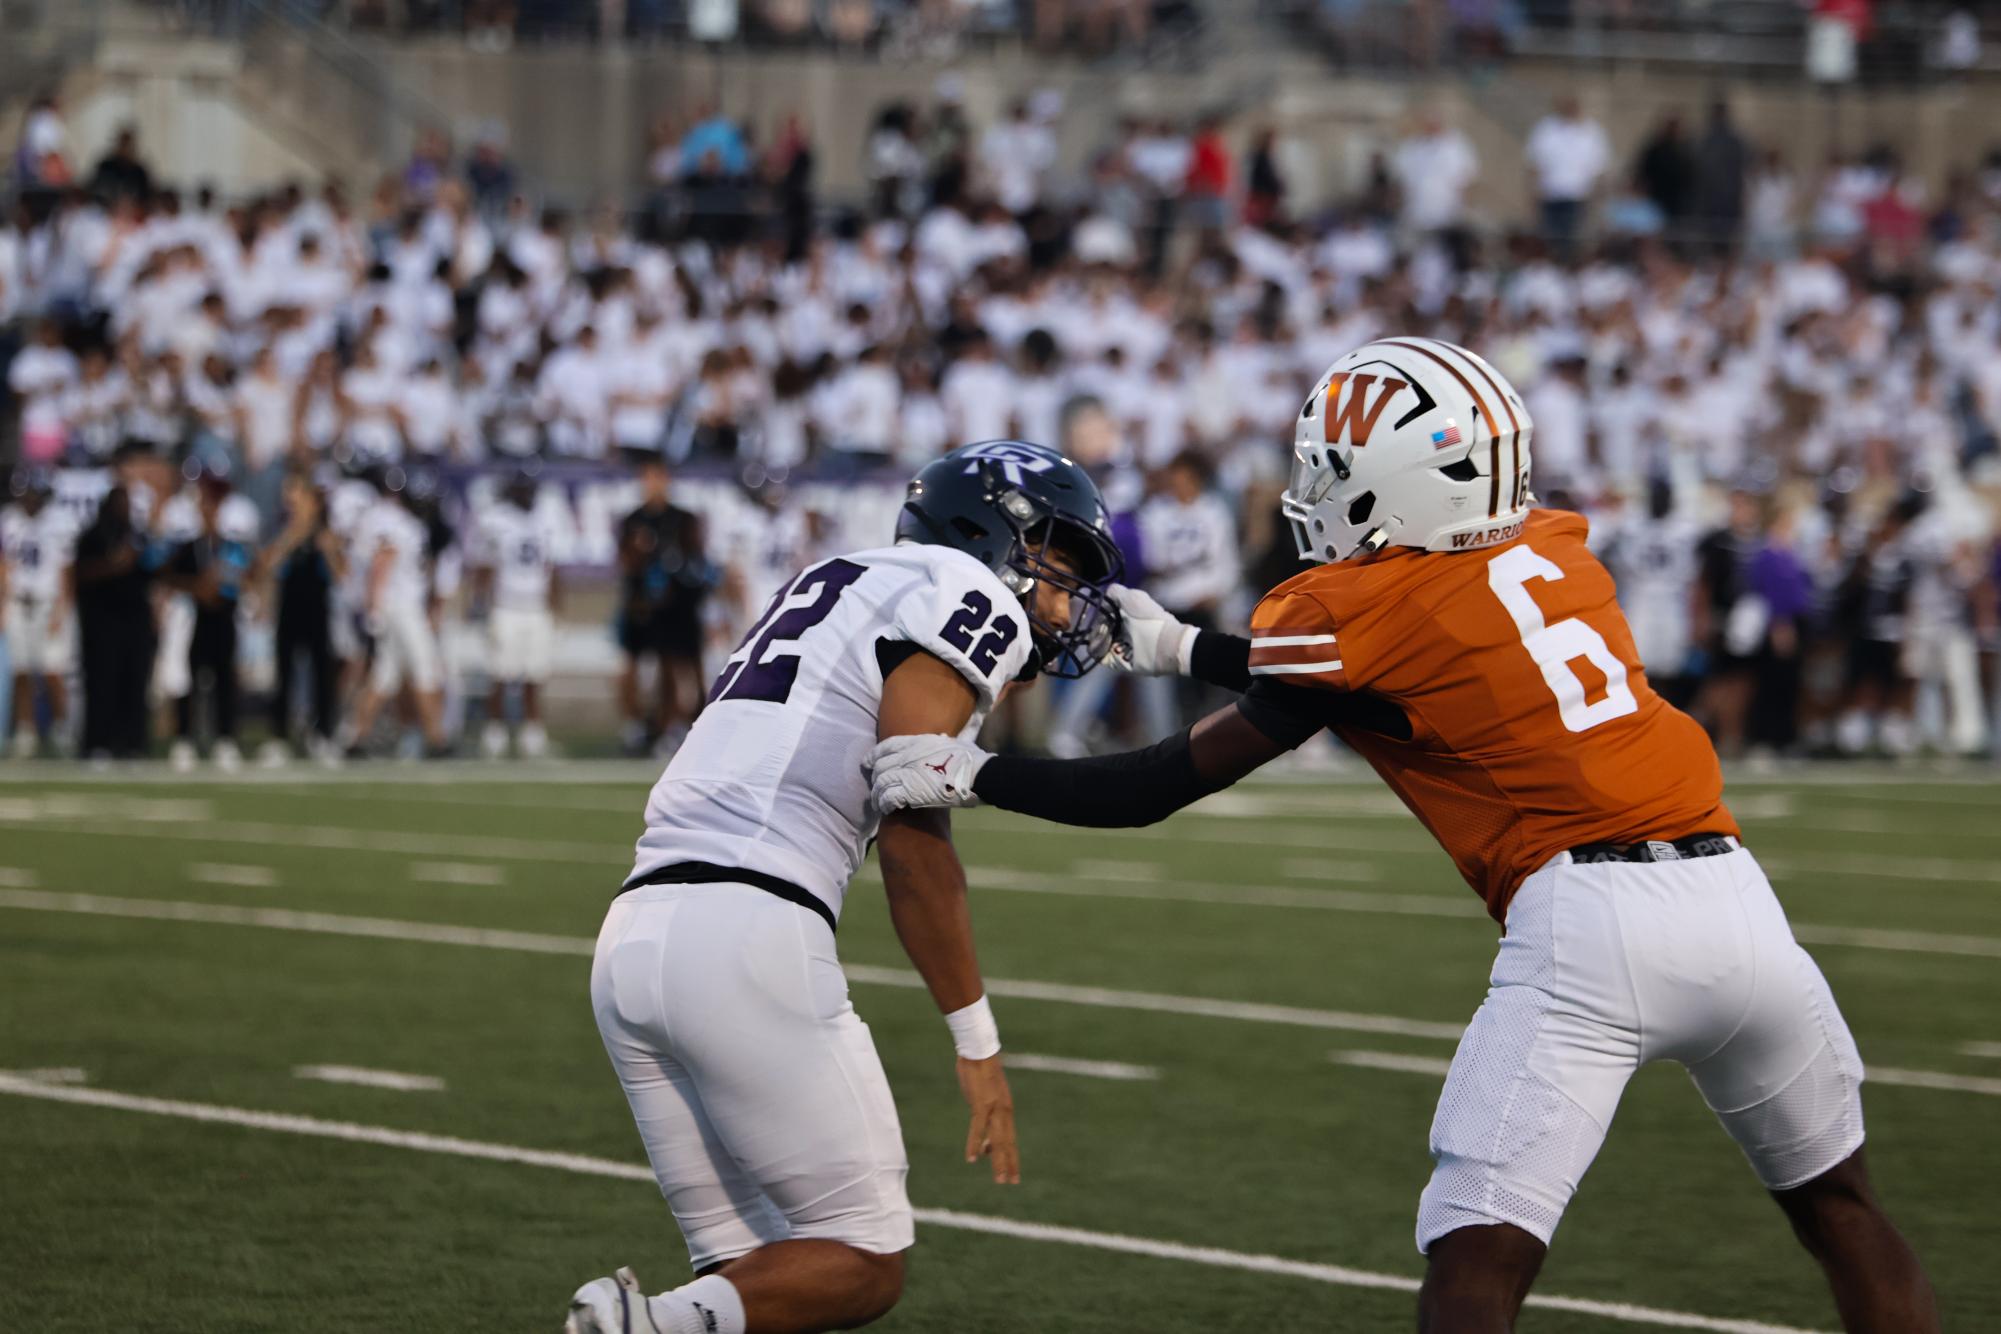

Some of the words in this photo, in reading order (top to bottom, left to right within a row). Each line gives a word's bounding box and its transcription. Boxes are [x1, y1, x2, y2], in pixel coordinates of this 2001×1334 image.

[1324, 372, 1408, 447] W
[938, 590, 1018, 678] 22
[1488, 544, 1639, 733] 6
